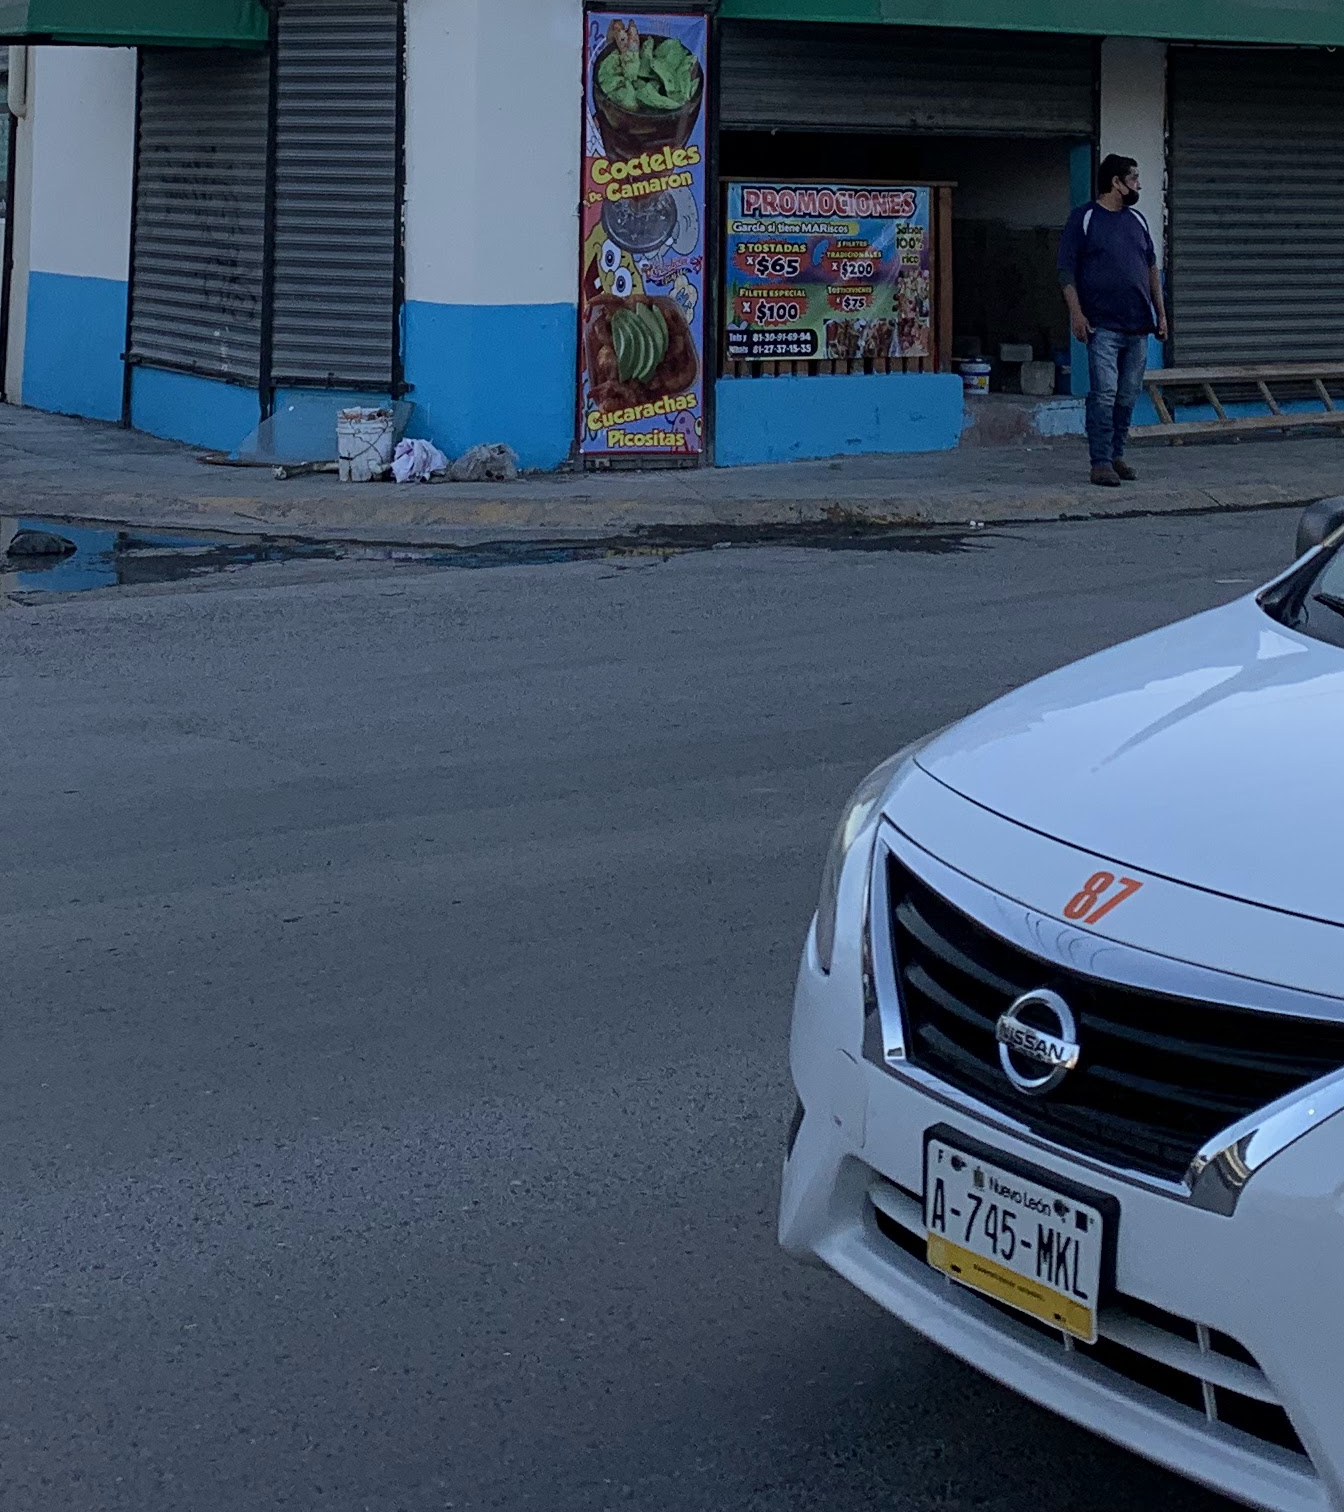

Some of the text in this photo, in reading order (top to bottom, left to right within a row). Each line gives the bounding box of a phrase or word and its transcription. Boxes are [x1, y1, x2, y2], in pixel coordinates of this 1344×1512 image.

[591, 145, 701, 185] Cocteles
[606, 171, 693, 202] Camaron
[743, 189, 916, 217] PROMOCIONES
[778, 223, 800, 233] tiene
[738, 243, 806, 254] 3 TOSTADAS
[902, 254, 919, 264] rico
[755, 254, 800, 278] $65
[841, 259, 873, 280] $200
[740, 288, 806, 298] FILETE ESPECIAL
[842, 295, 866, 311] $75
[755, 300, 799, 324] $100
[586, 392, 697, 430] Cucarachas
[607, 427, 685, 449] Picositas
[1063, 871, 1143, 925] 87
[1000, 1020, 1064, 1060] NISSAN
[989, 1176, 1052, 1217] Nuevo León
[932, 1177, 1088, 1300] A-745-MKL
